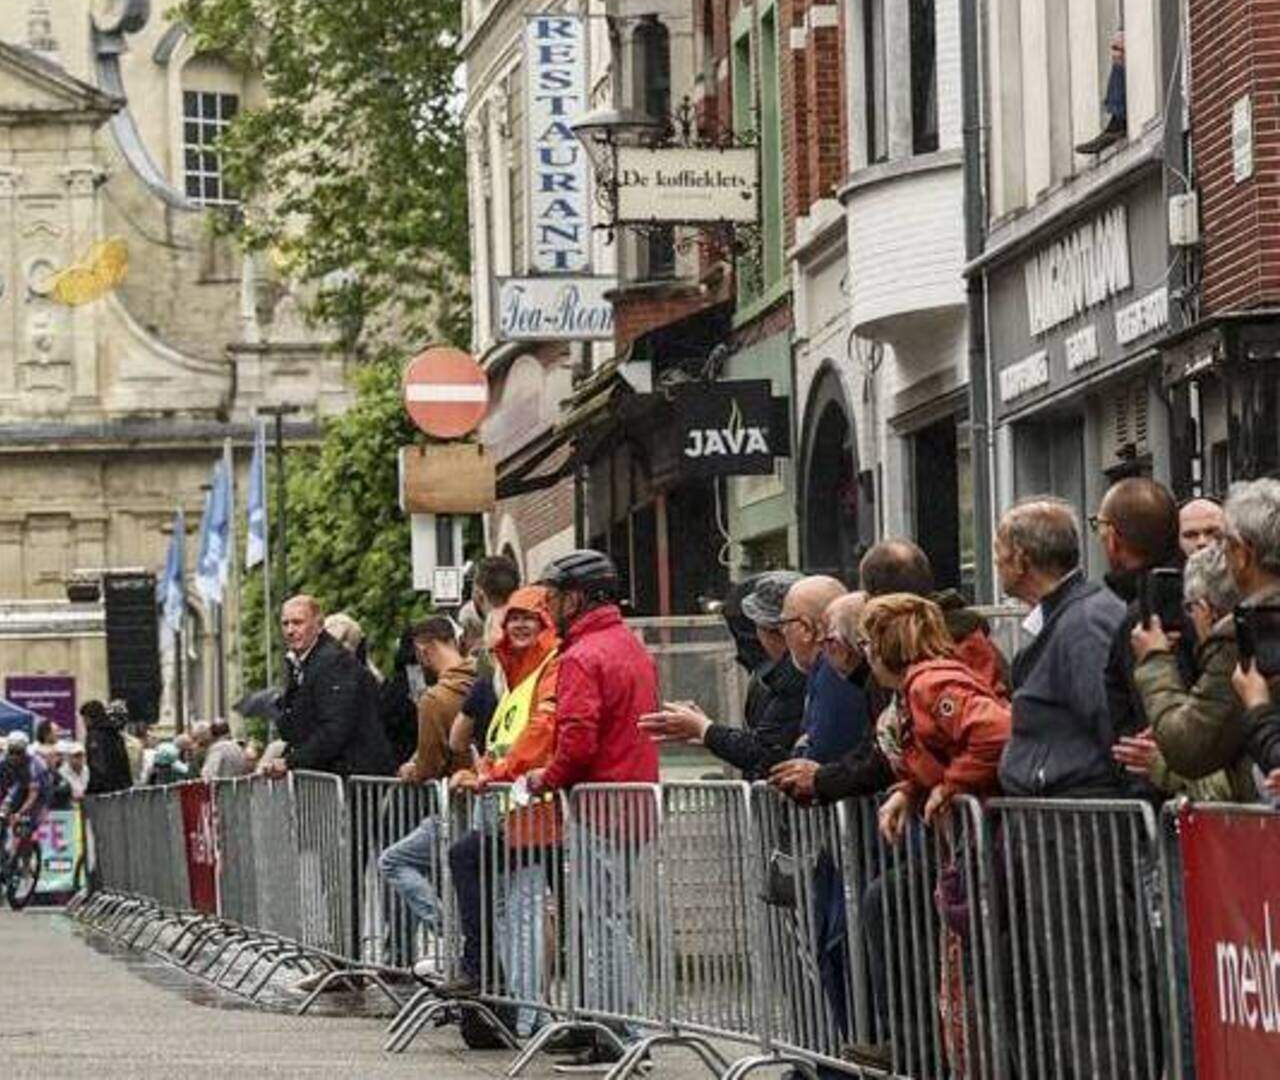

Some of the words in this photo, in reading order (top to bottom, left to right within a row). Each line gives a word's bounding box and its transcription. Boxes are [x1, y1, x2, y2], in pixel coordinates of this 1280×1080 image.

[536, 19, 583, 269] RESTAURANT
[623, 170, 650, 187] De
[684, 426, 770, 458] JAVA
